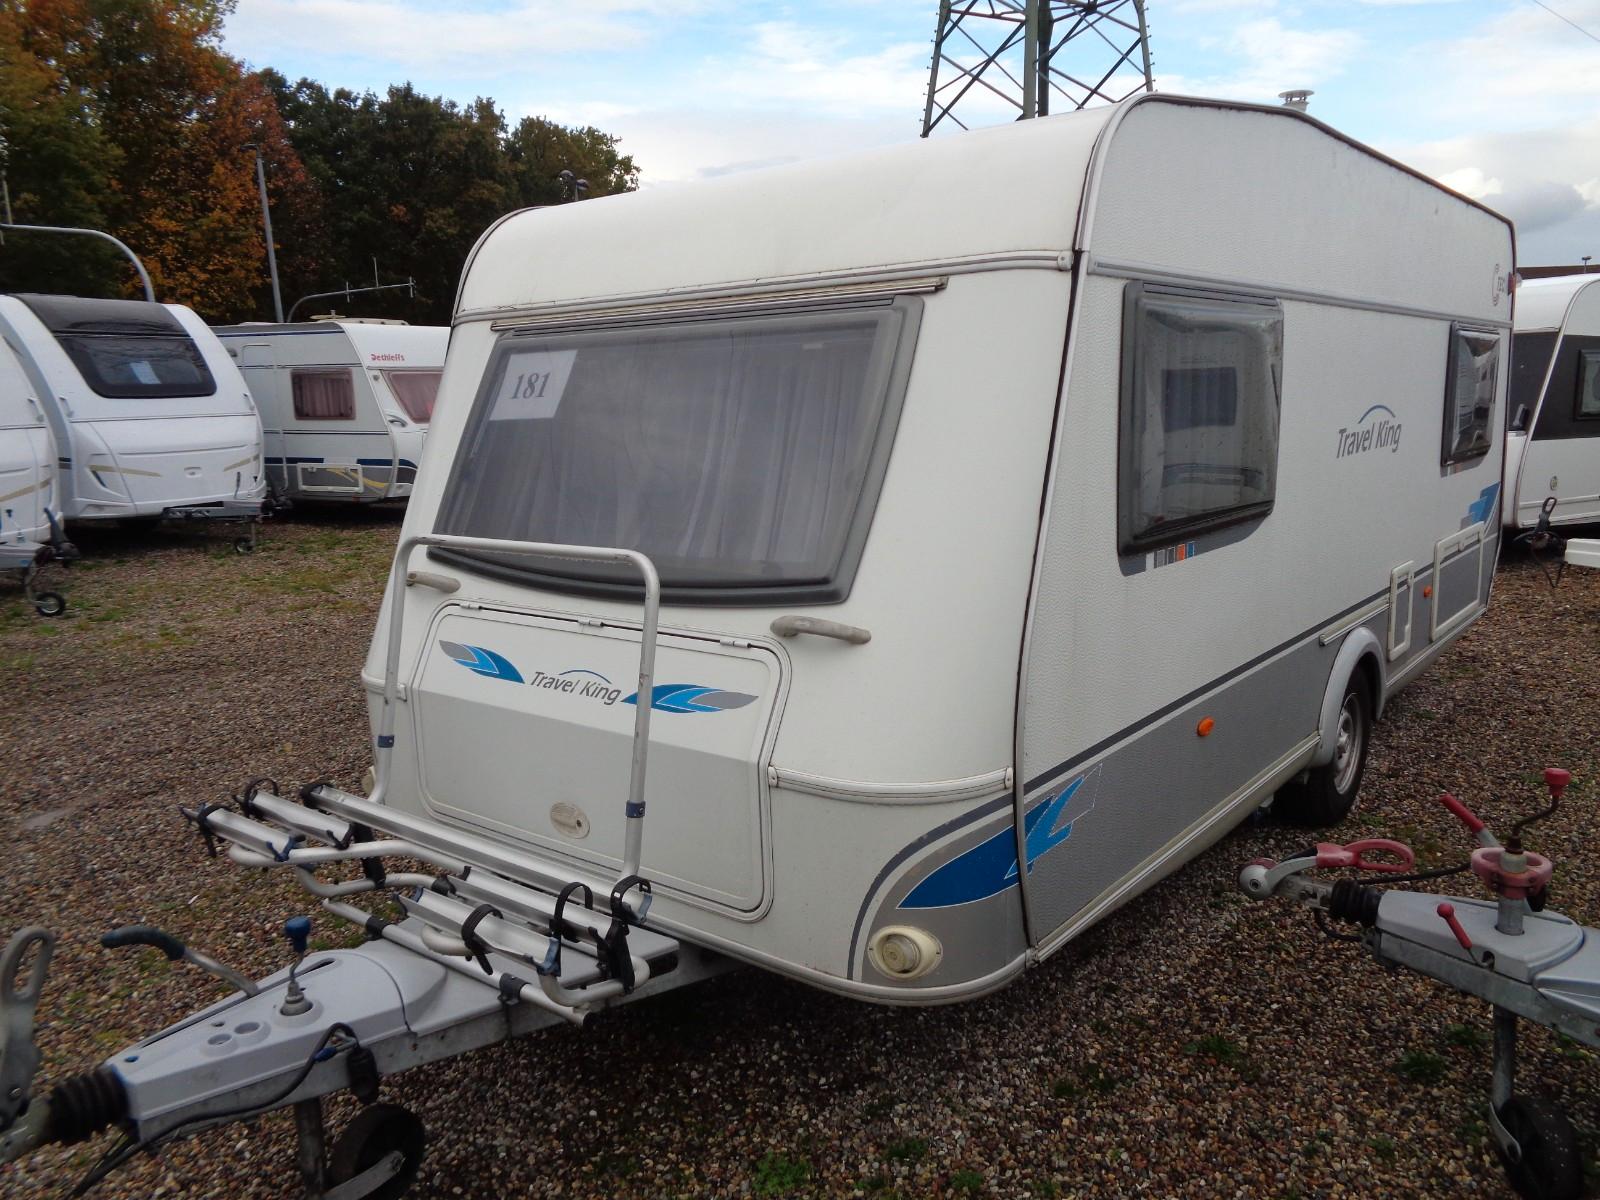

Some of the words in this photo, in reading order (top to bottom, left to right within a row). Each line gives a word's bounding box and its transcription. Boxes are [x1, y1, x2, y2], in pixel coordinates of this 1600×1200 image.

[510, 372, 551, 399] 181
[1336, 422, 1376, 459] Travel
[1375, 420, 1402, 453] King
[530, 671, 580, 694] Travel
[579, 680, 622, 706] King
